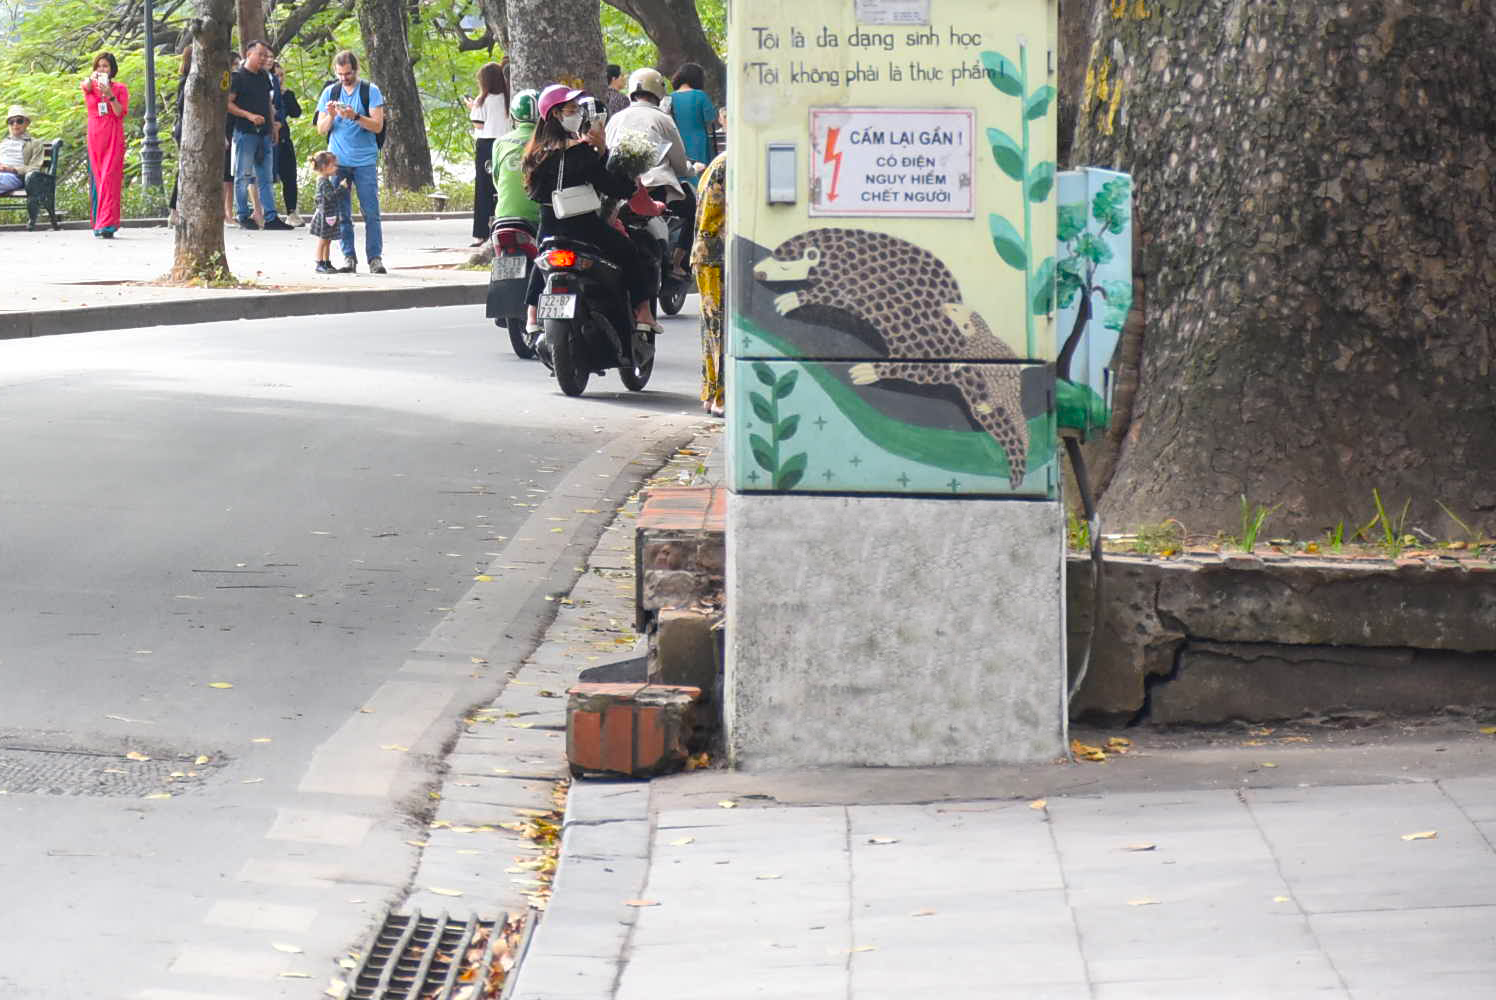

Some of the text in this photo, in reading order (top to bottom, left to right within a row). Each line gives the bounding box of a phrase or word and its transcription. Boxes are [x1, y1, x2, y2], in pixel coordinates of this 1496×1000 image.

[752, 25, 982, 51] Tôi là đa dạng sinh học
[750, 62, 779, 85] Tôi
[791, 61, 840, 86] không
[846, 61, 879, 87] phải
[889, 62, 902, 82] là
[850, 126, 884, 145] CẤM
[890, 131, 914, 148] LẠI
[876, 153, 935, 170] CÓ ĐIỆN
[866, 174, 906, 184] NGUY
[861, 188, 900, 202] CHẾT
